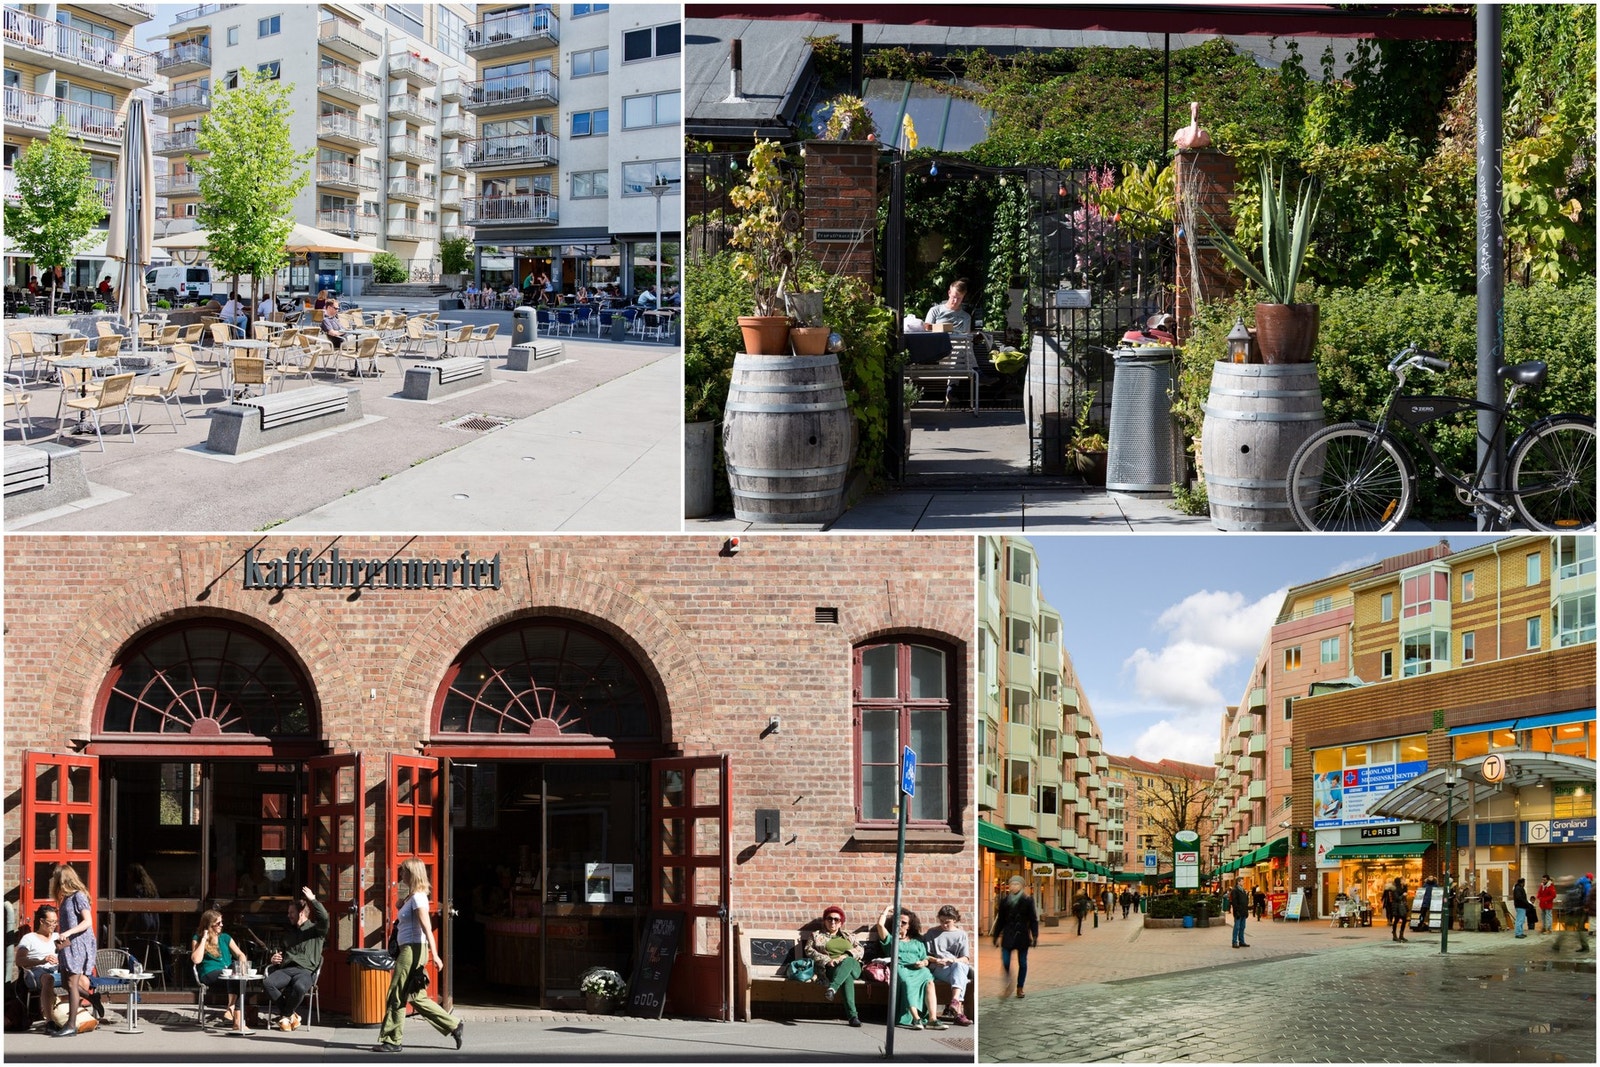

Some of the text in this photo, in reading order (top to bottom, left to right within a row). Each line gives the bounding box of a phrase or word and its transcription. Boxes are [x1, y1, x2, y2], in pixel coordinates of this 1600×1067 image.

[243, 548, 501, 589] Kaffebrenneriet
[1487, 761, 1497, 776] T
[1553, 819, 1588, 829] Grønland
[1363, 828, 1397, 836] FLORISS
